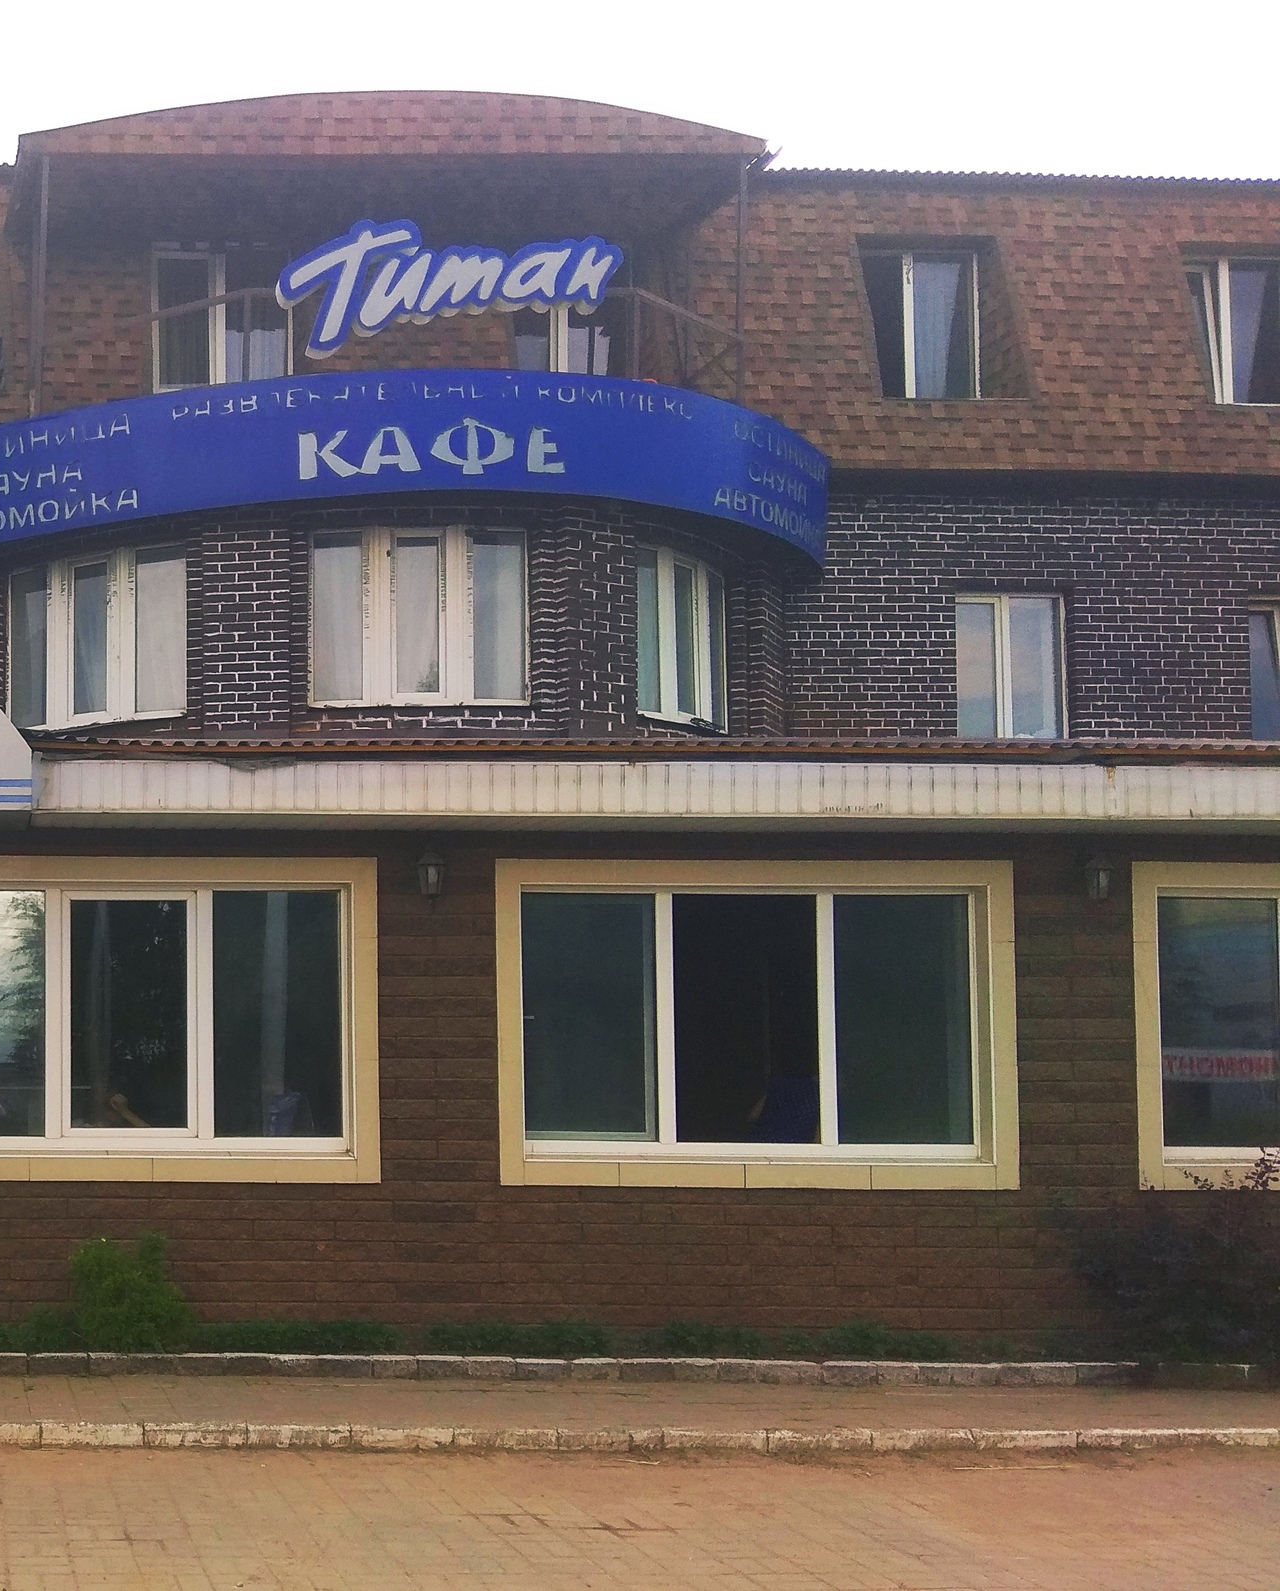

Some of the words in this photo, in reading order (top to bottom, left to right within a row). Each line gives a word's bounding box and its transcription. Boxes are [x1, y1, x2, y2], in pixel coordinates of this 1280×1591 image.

[297, 416, 566, 481] КАФЕ
[748, 461, 808, 507] САУНА
[713, 487, 823, 551] АВТОМОЙ
